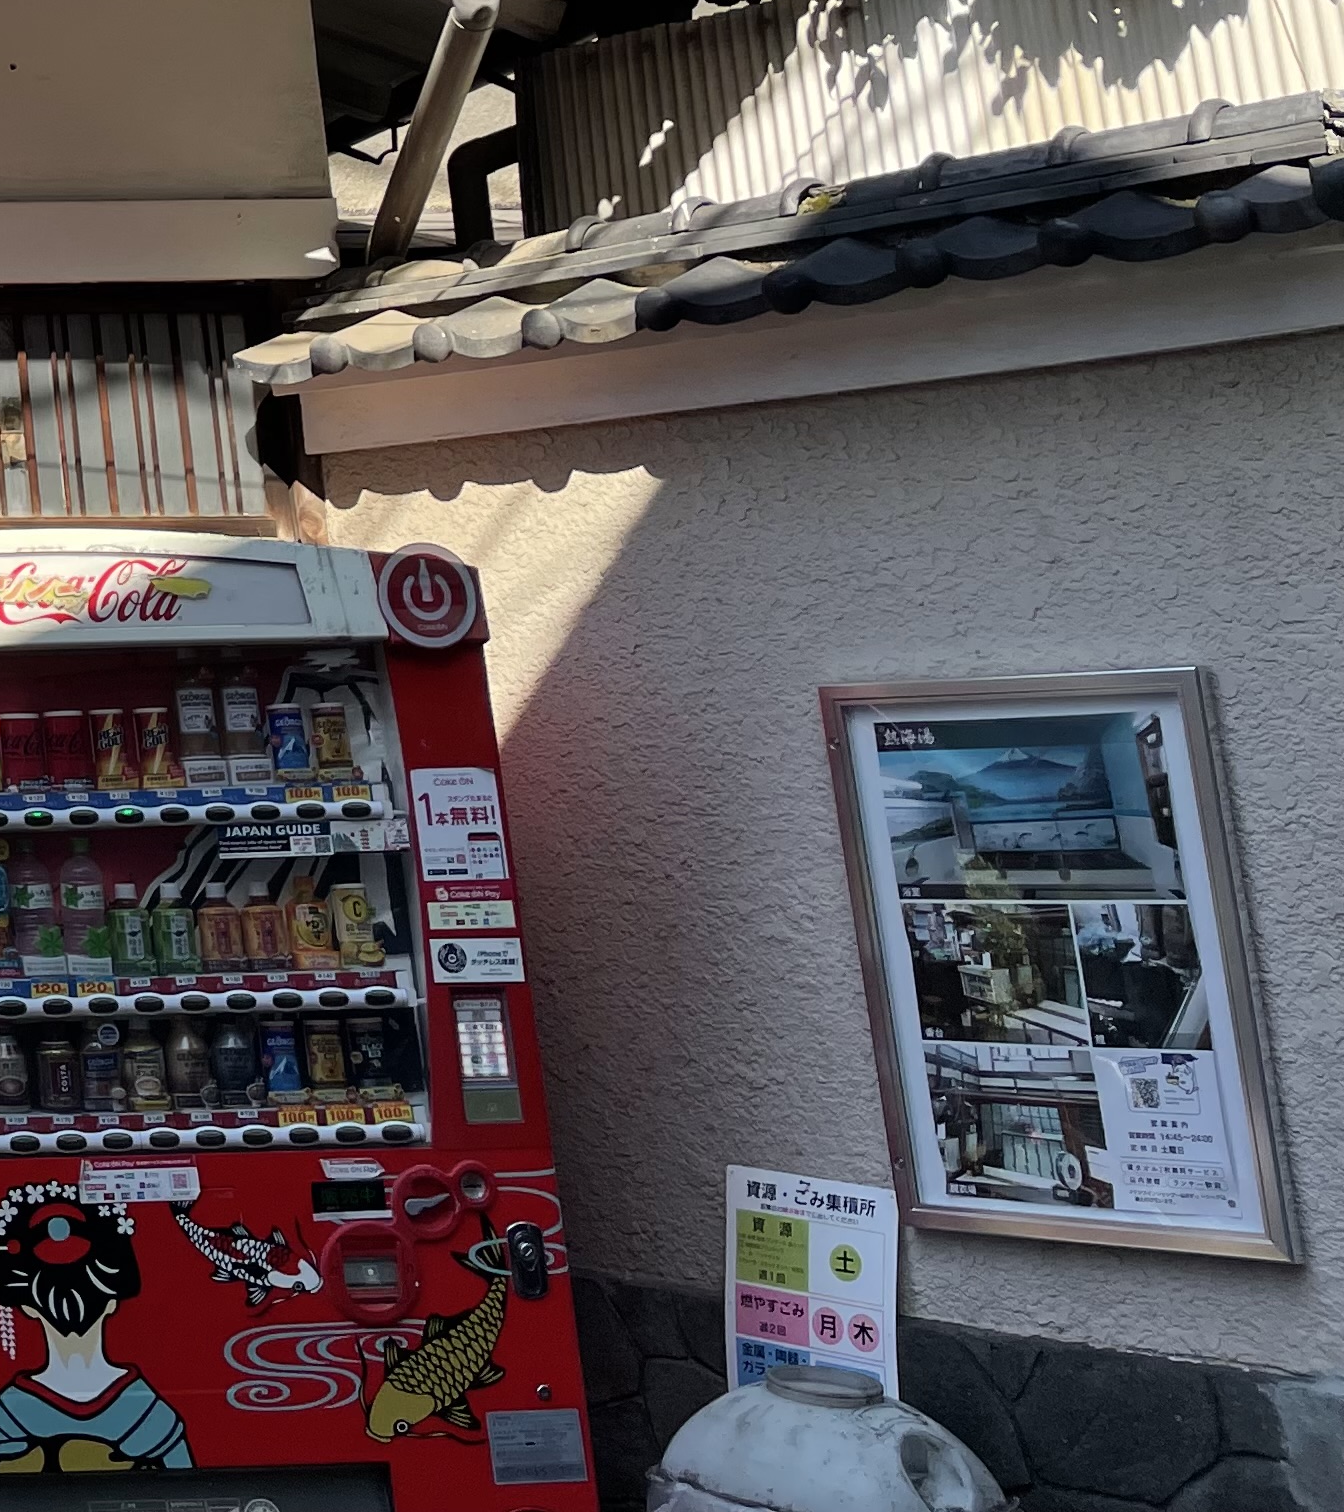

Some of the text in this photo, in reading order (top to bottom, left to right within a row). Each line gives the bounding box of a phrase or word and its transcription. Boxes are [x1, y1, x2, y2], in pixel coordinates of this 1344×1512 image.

[226, 823, 321, 837] JAPAN GUIDE
[746, 1179, 876, 1218] 資源・ごみ集積所
[835, 1250, 856, 1274] 土
[758, 1269, 786, 1284] 週1回
[740, 1293, 804, 1317] 燃やすごみ
[820, 1314, 837, 1339] 月
[853, 1321, 874, 1346] 木
[743, 1360, 773, 1376] ガラ
